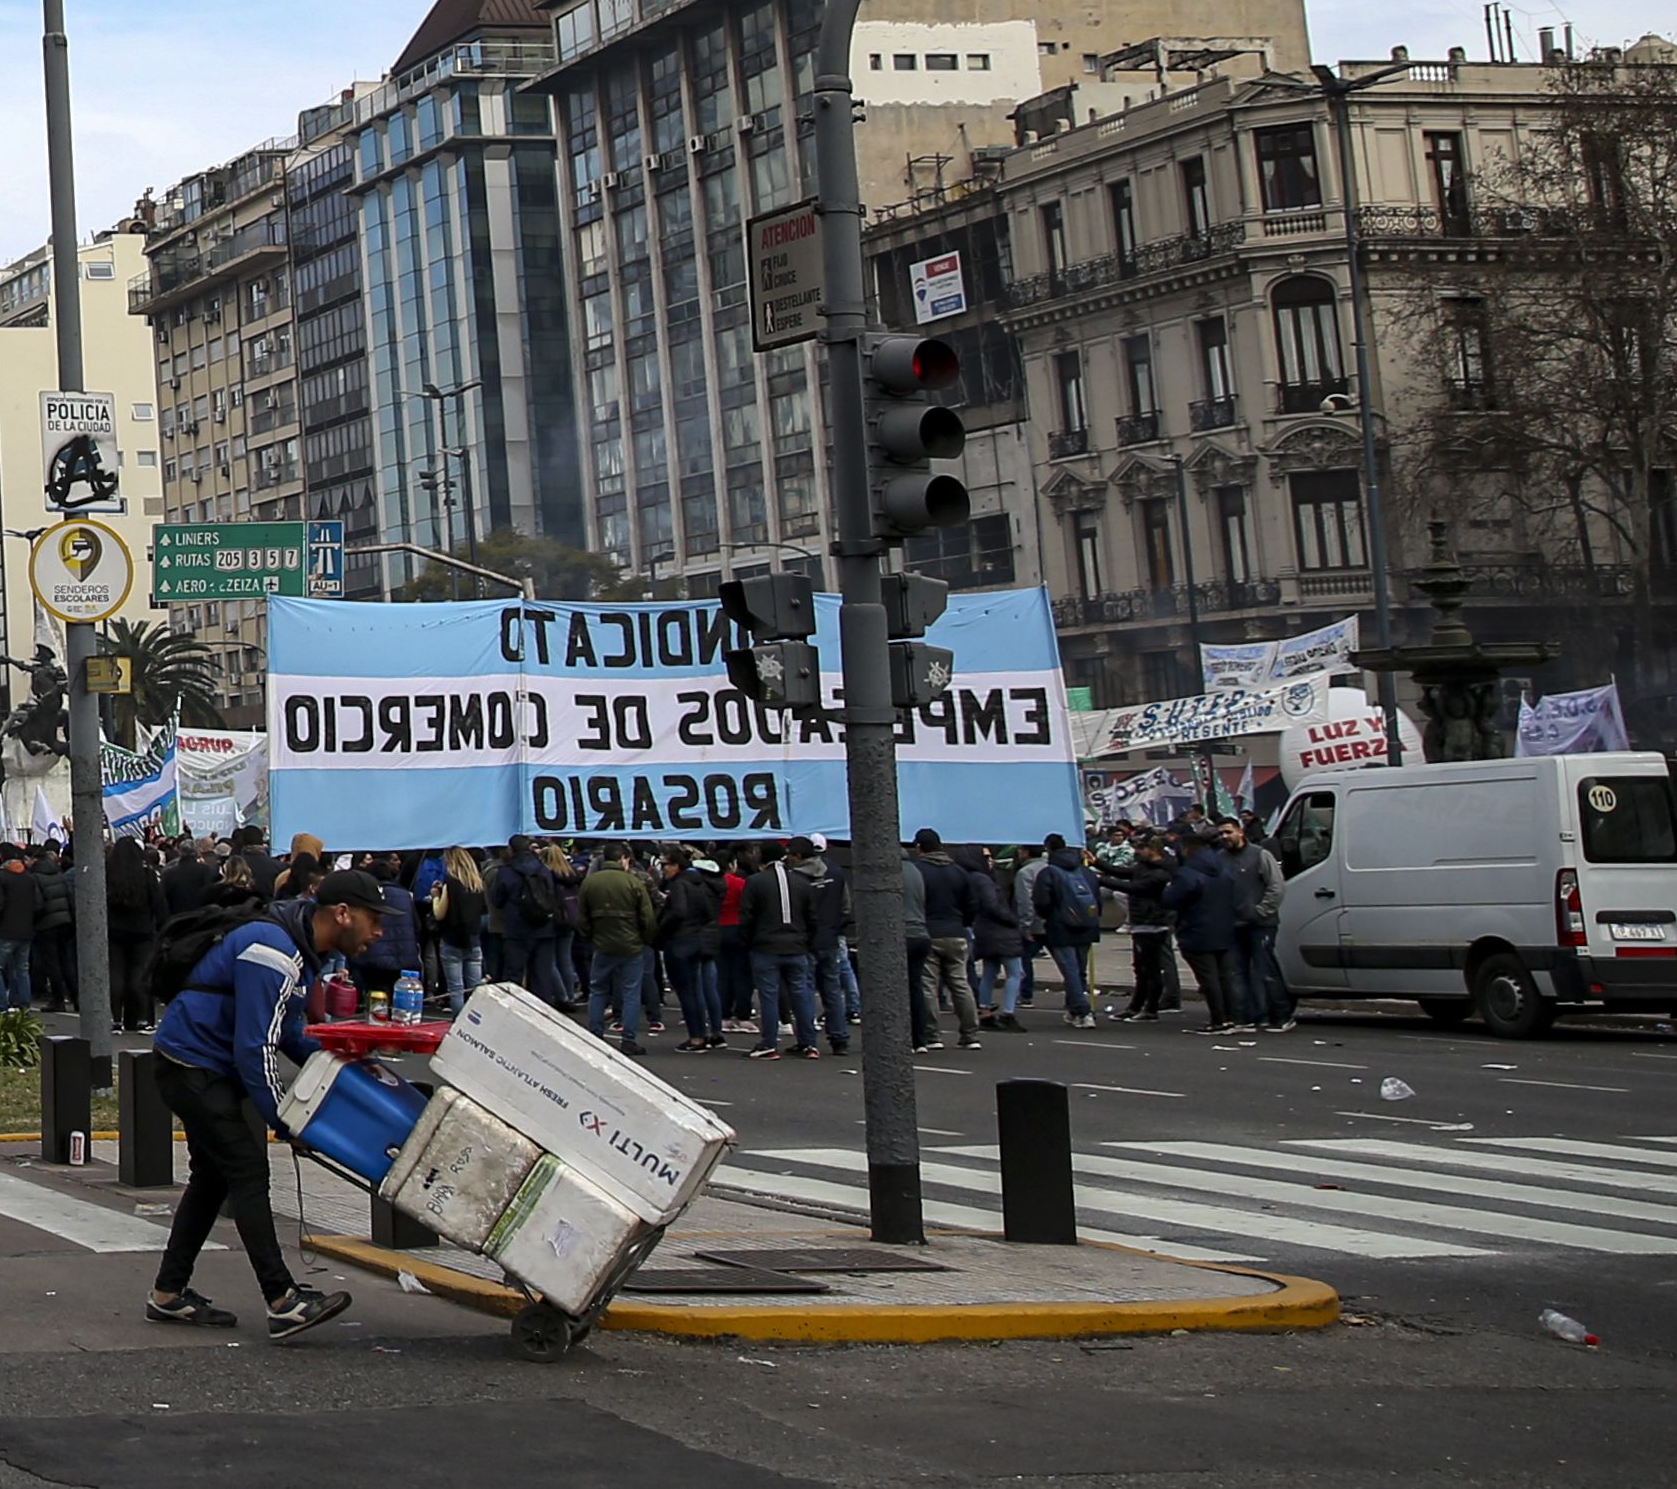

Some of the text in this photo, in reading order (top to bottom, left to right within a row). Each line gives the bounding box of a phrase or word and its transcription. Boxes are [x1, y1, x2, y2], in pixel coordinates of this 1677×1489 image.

[761, 213, 816, 249] ATENCION
[775, 289, 821, 313] DESTELLANTE
[47, 403, 110, 421] POLICIA
[47, 420, 111, 433] DE LA CIUDAD
[175, 531, 220, 546] LINIERS
[175, 550, 297, 568] RUTAS 205 3 5 7
[54, 585, 109, 594] SENDEROS
[175, 579, 206, 593] AERO
[312, 581, 340, 592] AU-1
[1308, 716, 1383, 744] LUZ Y
[1300, 737, 1407, 768] FUERZ
[1591, 789, 1614, 809] 110
[456, 1027, 495, 1060] SALMON
[495, 1057, 538, 1092] ATLANTIC
[538, 1087, 569, 1110] FRESH
[608, 1129, 681, 1186] MULTI
